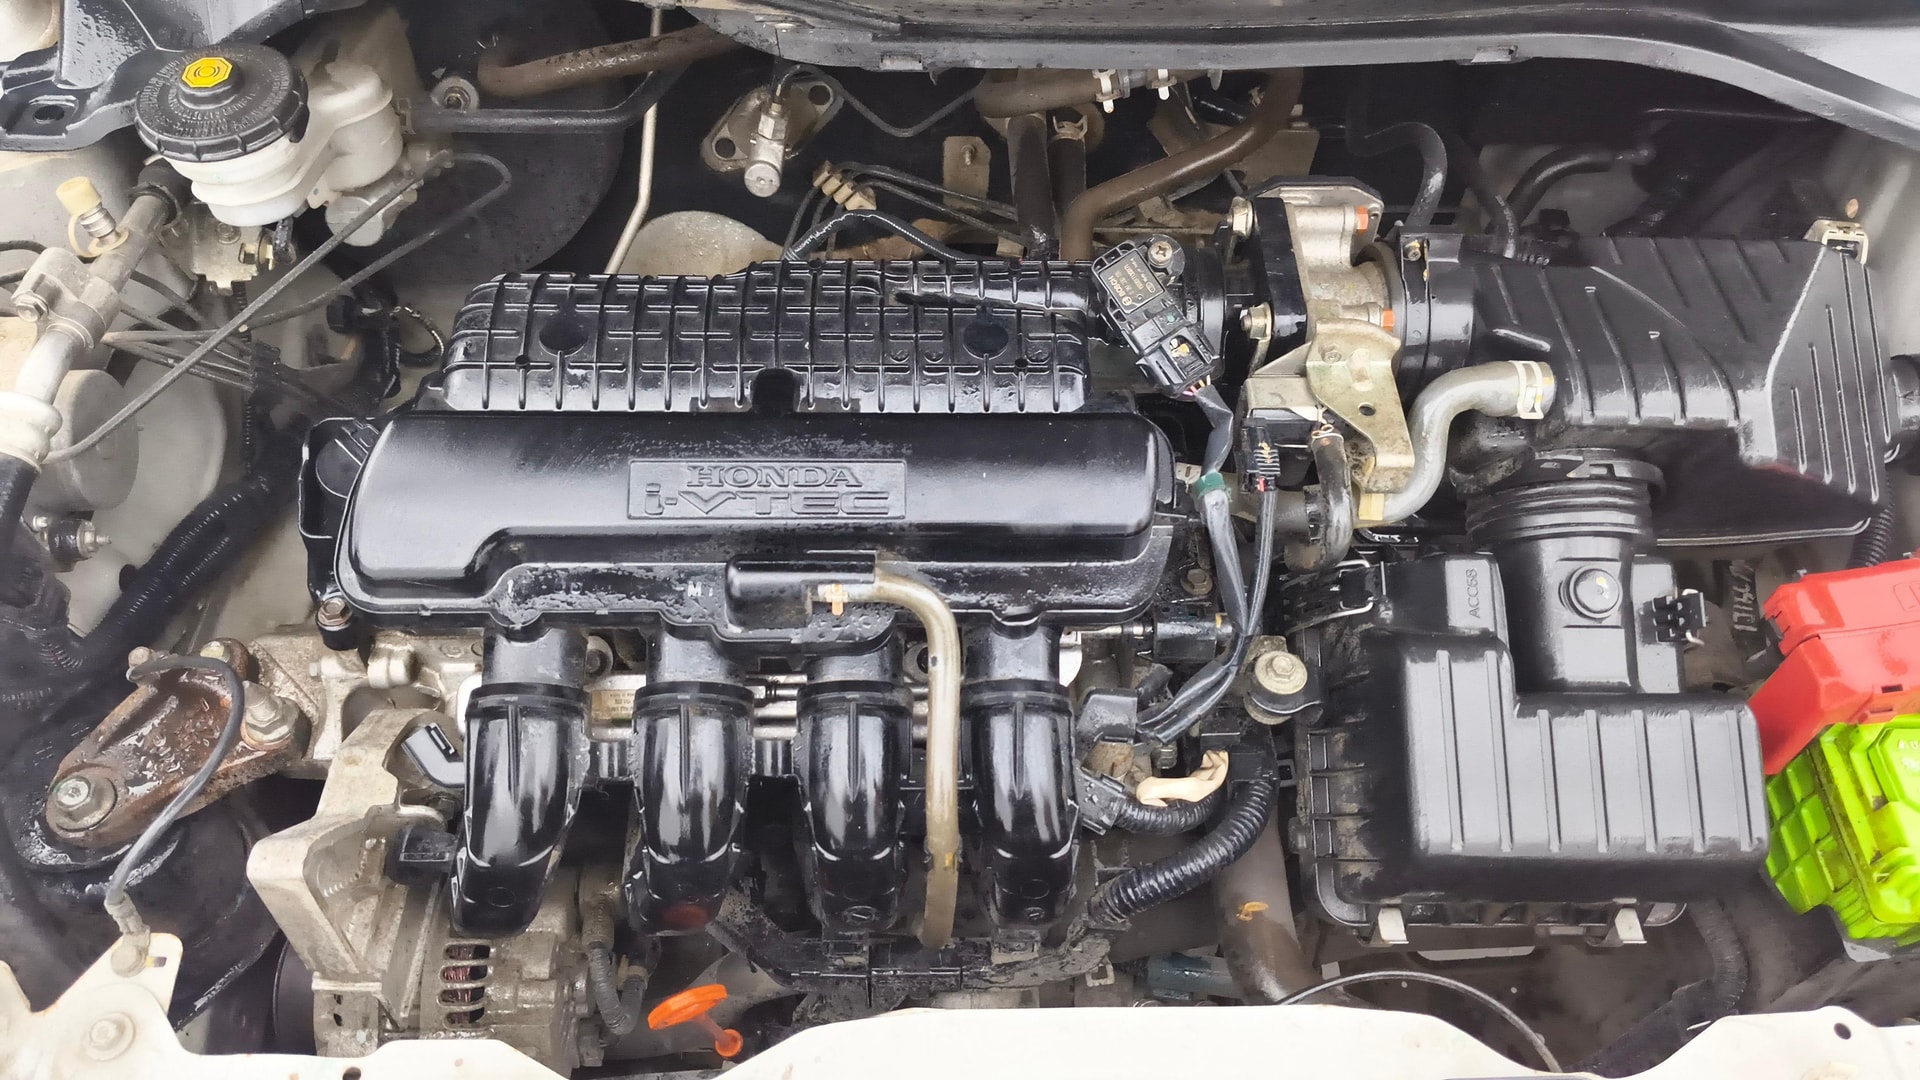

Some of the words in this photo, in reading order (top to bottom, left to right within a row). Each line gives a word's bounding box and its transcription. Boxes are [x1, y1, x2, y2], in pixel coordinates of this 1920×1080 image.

[1108, 275, 1126, 297] BOSCH
[686, 465, 863, 488] HONDA
[644, 482, 890, 516] i-VTEC
